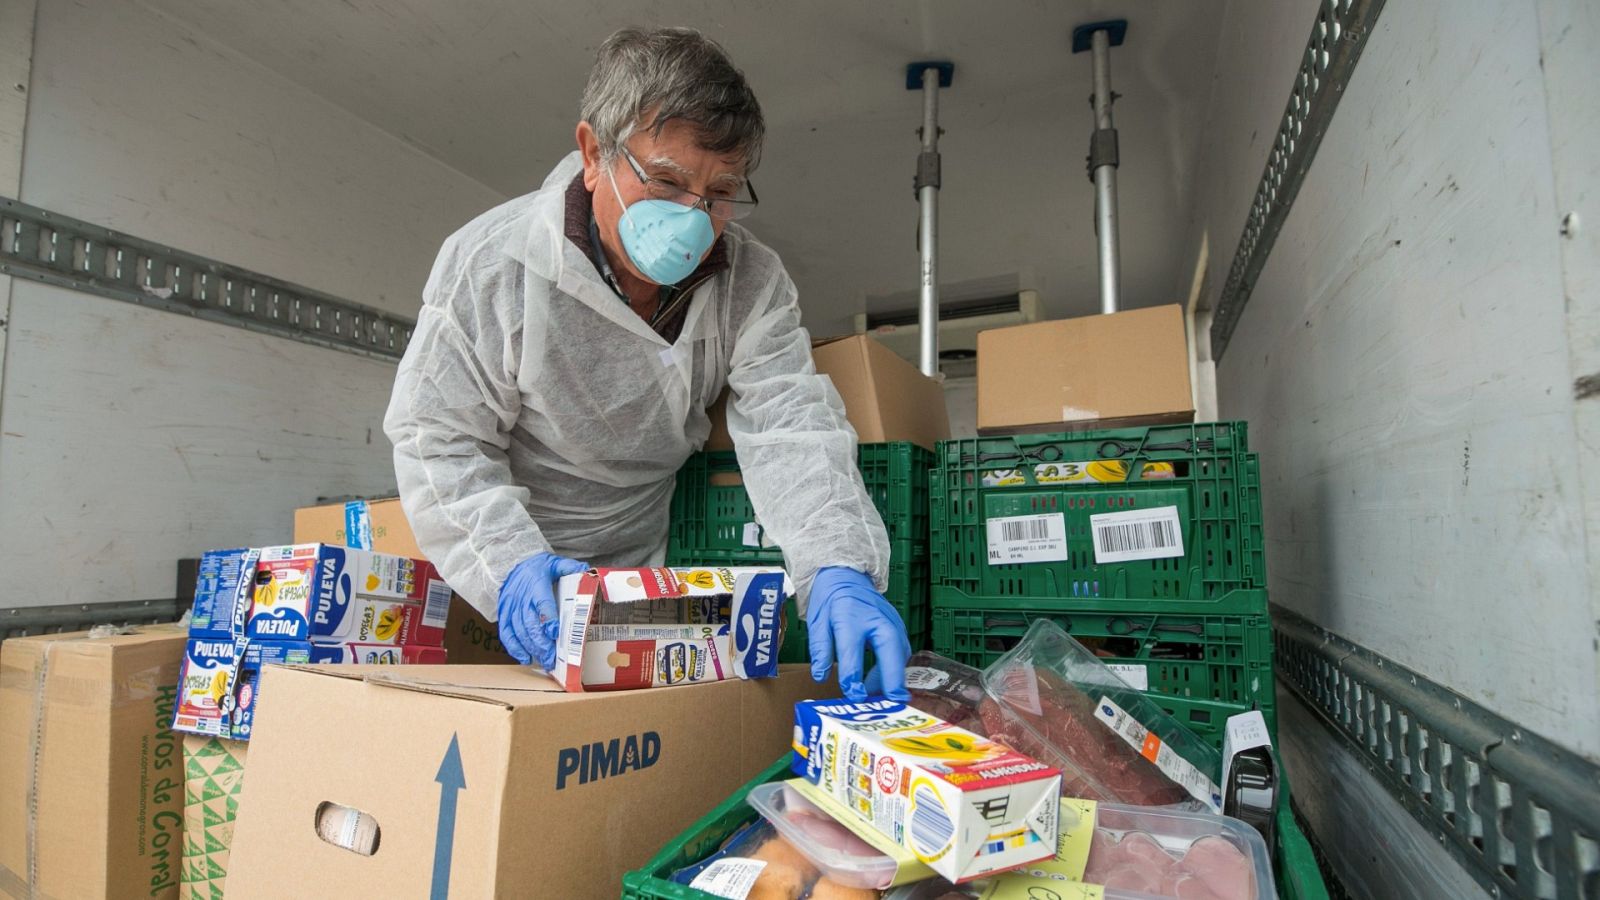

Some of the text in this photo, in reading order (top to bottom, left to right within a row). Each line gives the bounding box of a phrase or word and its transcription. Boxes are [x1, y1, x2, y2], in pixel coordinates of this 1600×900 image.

[1063, 464, 1079, 476] 3
[989, 550, 1002, 559] ML
[235, 567, 253, 626] PULEVA
[315, 558, 336, 625] PULEVA
[256, 619, 300, 636] PULEVA
[400, 607, 413, 645] ALMENDRAS
[755, 588, 778, 666] PULEVA
[194, 641, 234, 657] PULEVA
[813, 700, 900, 715] PULEVA
[555, 731, 661, 790] PIMAD
[807, 725, 819, 778] PULEVA
[979, 762, 1049, 779] ALMENDRAS
[153, 778, 179, 805] de
[150, 811, 183, 897] Corral
